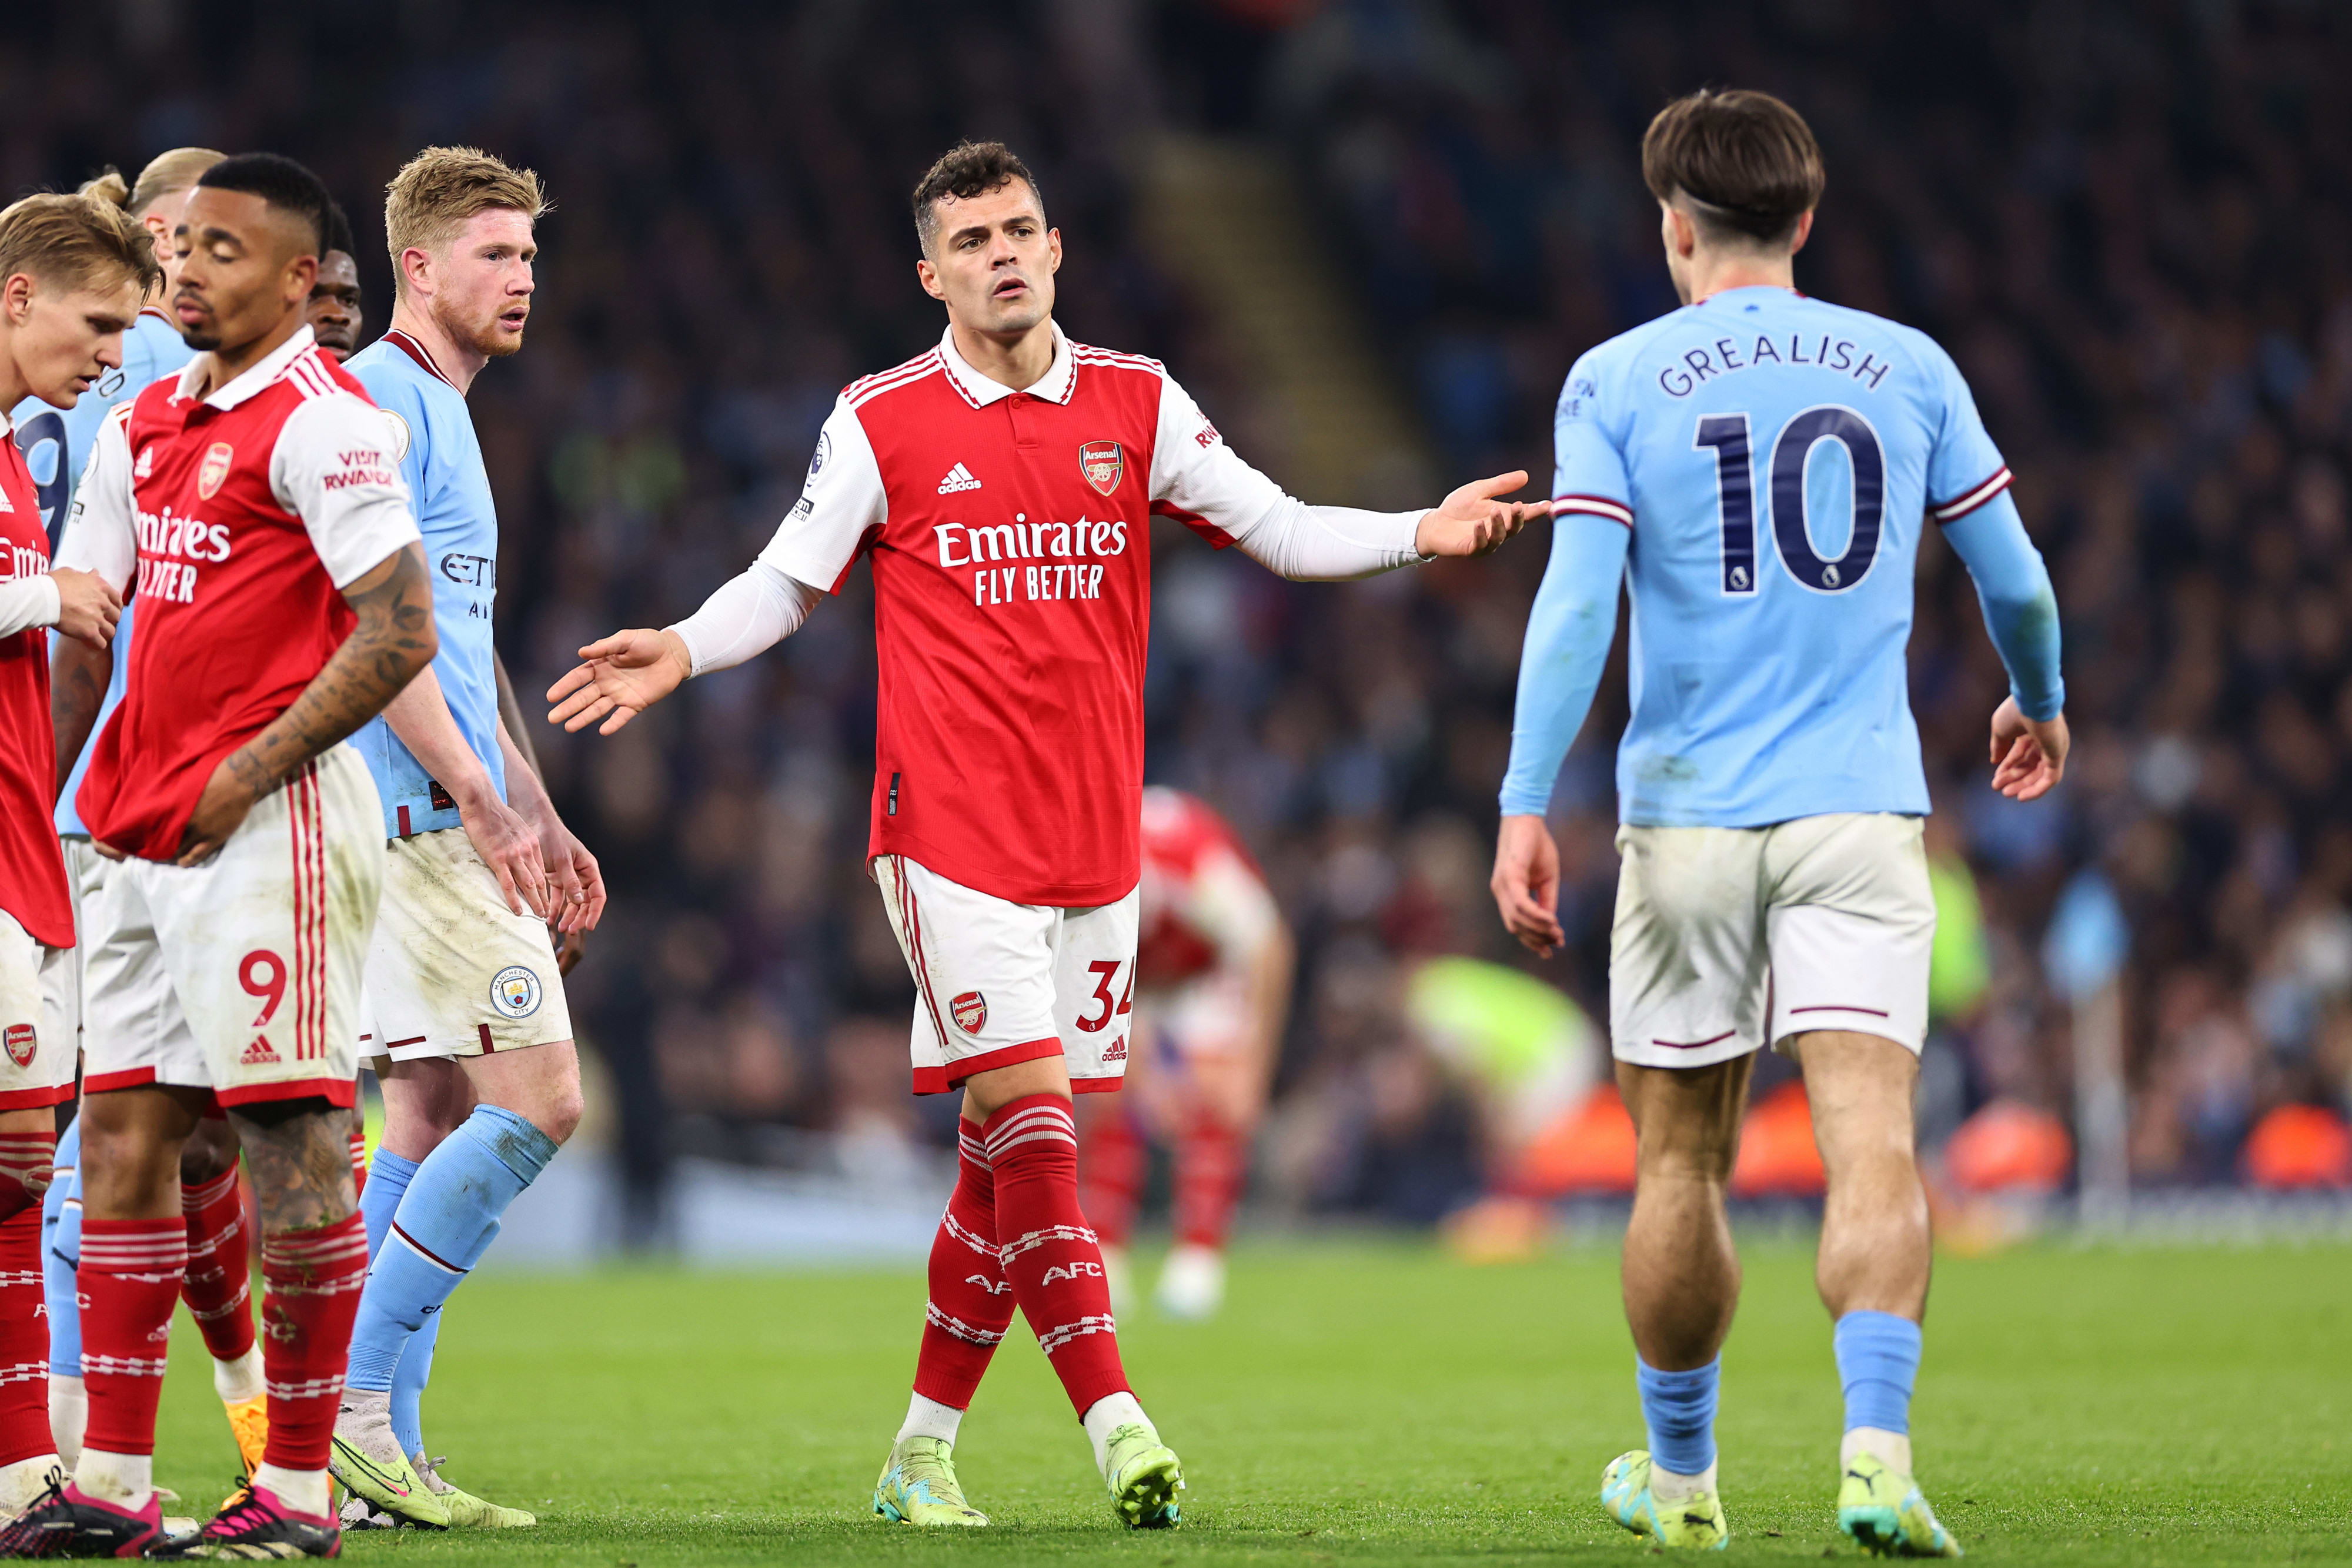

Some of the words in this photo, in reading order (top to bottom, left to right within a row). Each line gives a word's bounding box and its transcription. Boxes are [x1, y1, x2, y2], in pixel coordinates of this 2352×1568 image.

[1659, 333, 1889, 397] GREALISH
[338, 450, 380, 466] VISIT
[1084, 449, 1117, 460] Arsenal
[937, 479, 983, 496] adidas
[1693, 404, 1886, 595] 10
[932, 512, 1127, 568] Emirates
[975, 566, 1017, 606] FLY
[1025, 564, 1104, 601] BETTER
[238, 950, 287, 1027] 9
[494, 969, 534, 990] MANCHESTER
[954, 996, 980, 1010] Arsenal
[1075, 955, 1135, 1033] 34
[513, 1007, 529, 1015] CITY
[1101, 1051, 1127, 1062] adidas
[965, 1274, 1012, 1296] AF
[1041, 1261, 1104, 1287] AFC
